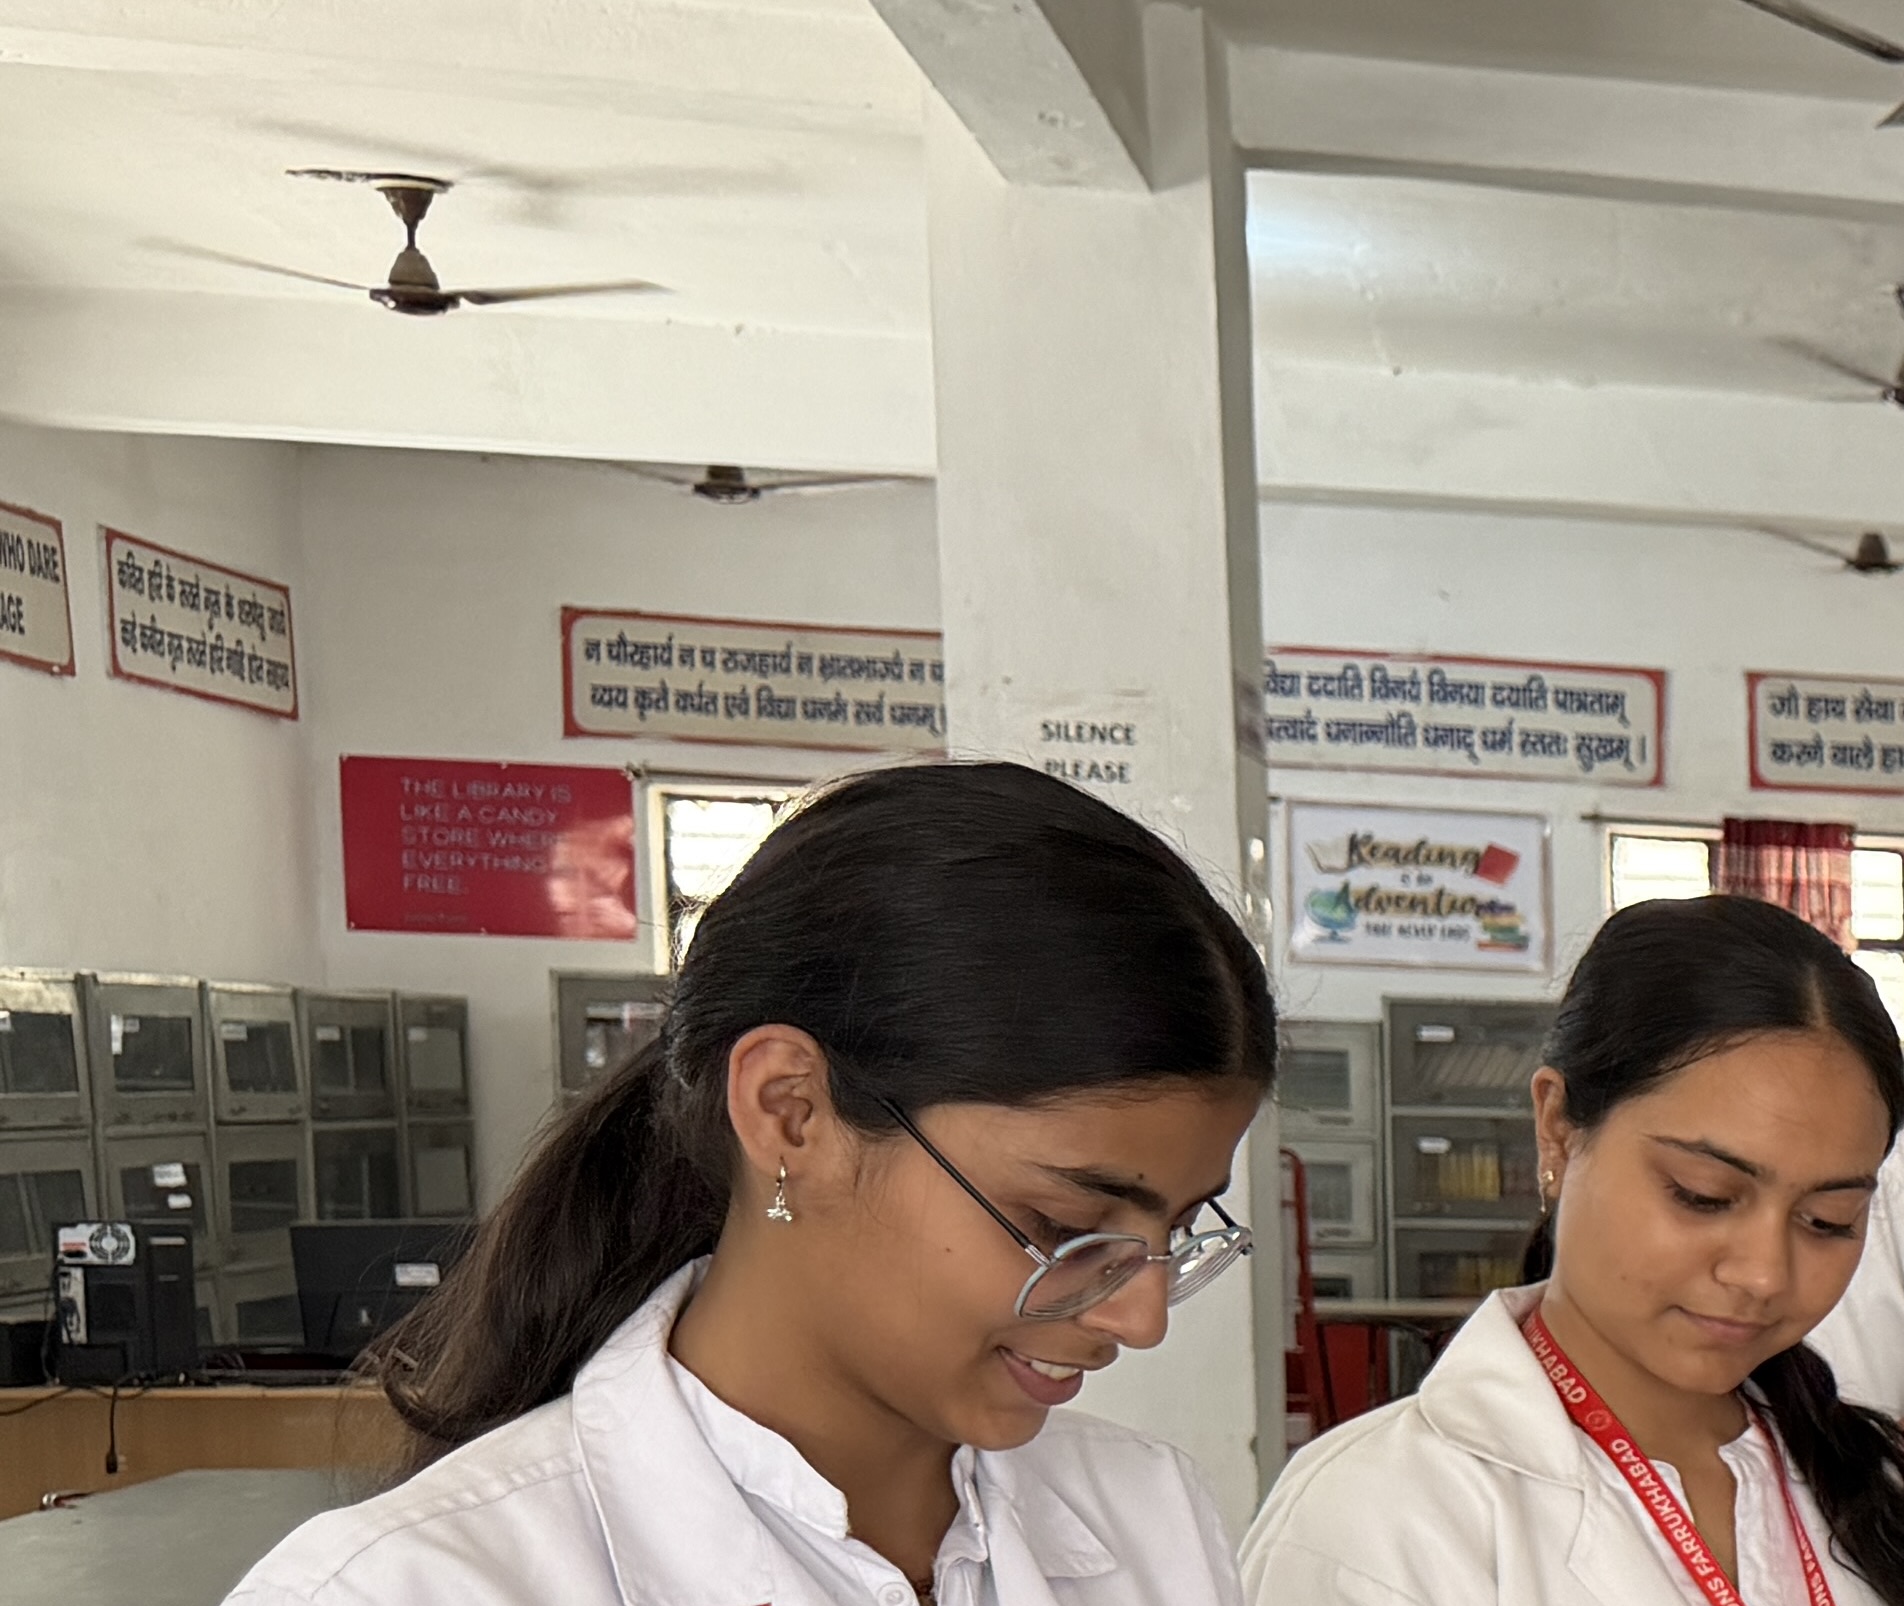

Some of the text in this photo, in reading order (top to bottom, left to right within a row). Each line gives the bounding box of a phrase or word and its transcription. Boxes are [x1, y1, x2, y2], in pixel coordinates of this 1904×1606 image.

[27, 538, 60, 583] DARE
[1041, 720, 1137, 745] SILENCE
[1045, 759, 1131, 784] PLEASE
[402, 776, 444, 798] THE
[452, 781, 545, 801] LIBRARY
[400, 803, 558, 827] LIKE A CANDY
[402, 825, 479, 847] STORE
[402, 849, 548, 874] EVERYTHING
[1349, 831, 1481, 877] Reading
[1611, 1438, 1715, 1577] FARRUKHABAD
